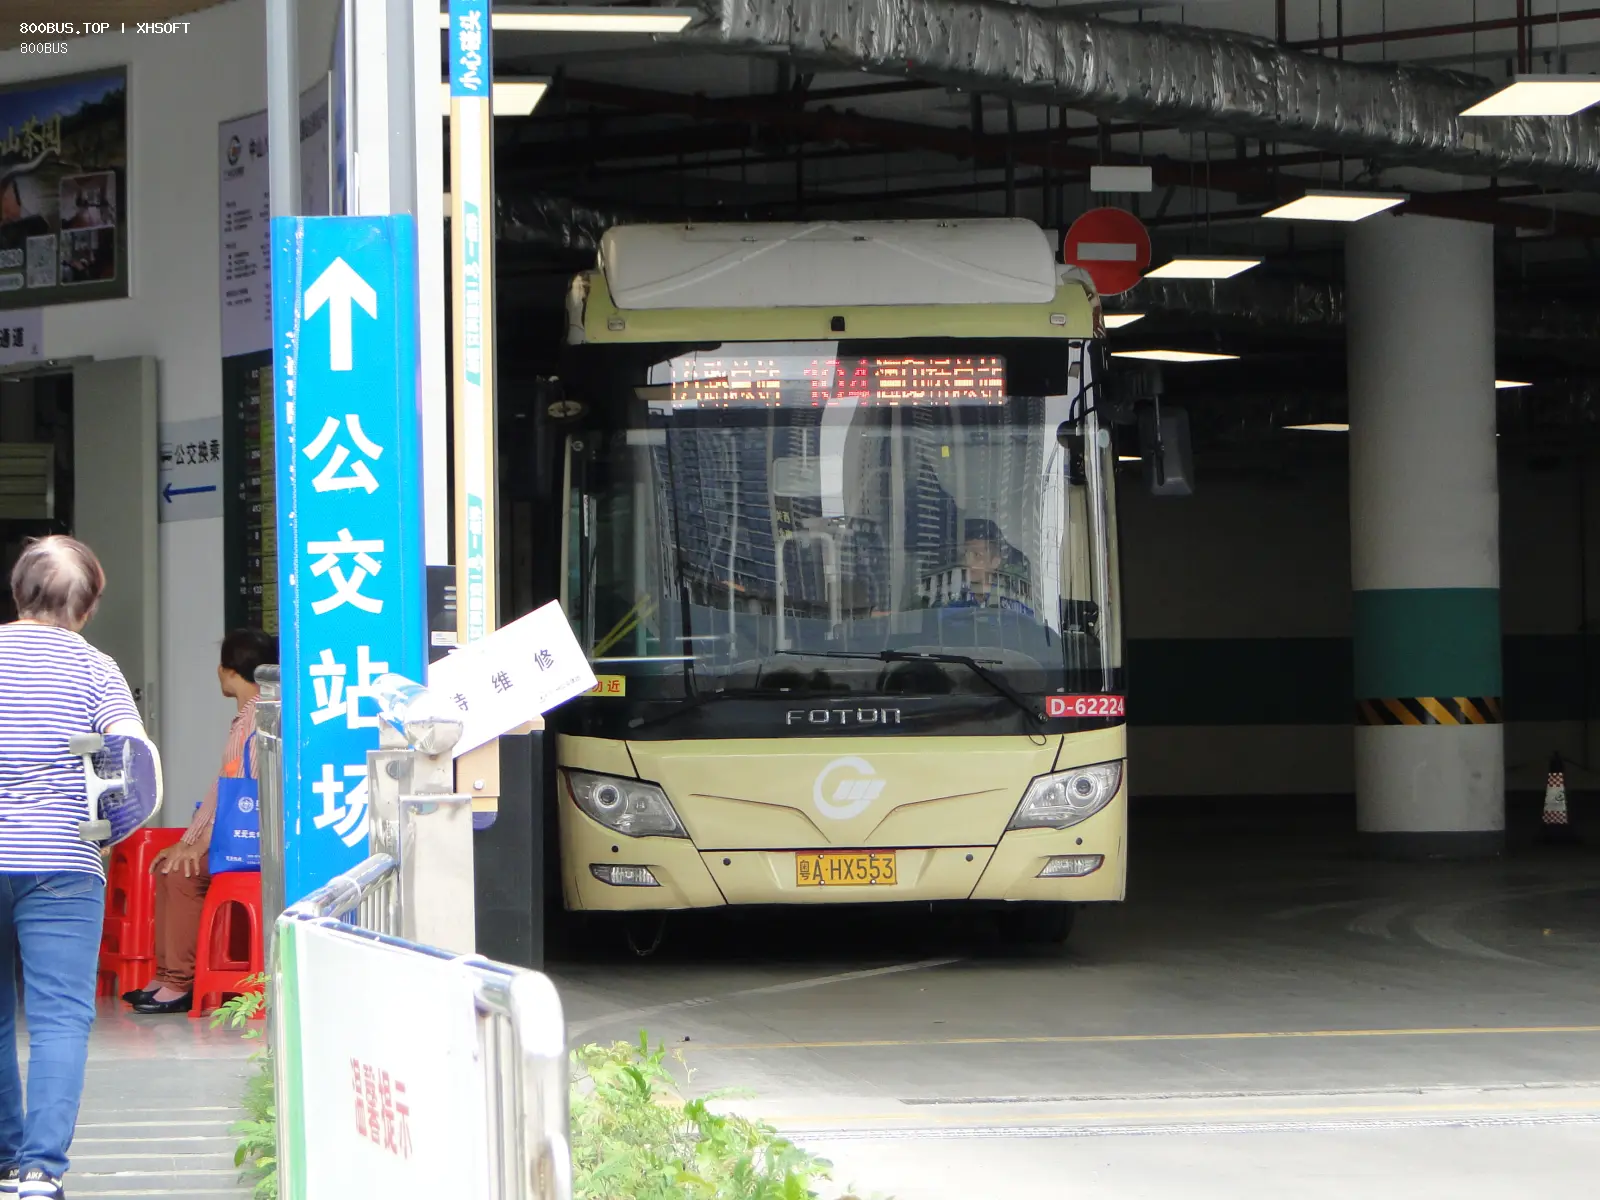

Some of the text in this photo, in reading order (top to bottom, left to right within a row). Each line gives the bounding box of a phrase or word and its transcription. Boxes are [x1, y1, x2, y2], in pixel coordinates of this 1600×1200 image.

[302, 413, 389, 849] 公交站场
[1051, 697, 1124, 715] D-62224
[785, 708, 901, 725] FOTON
